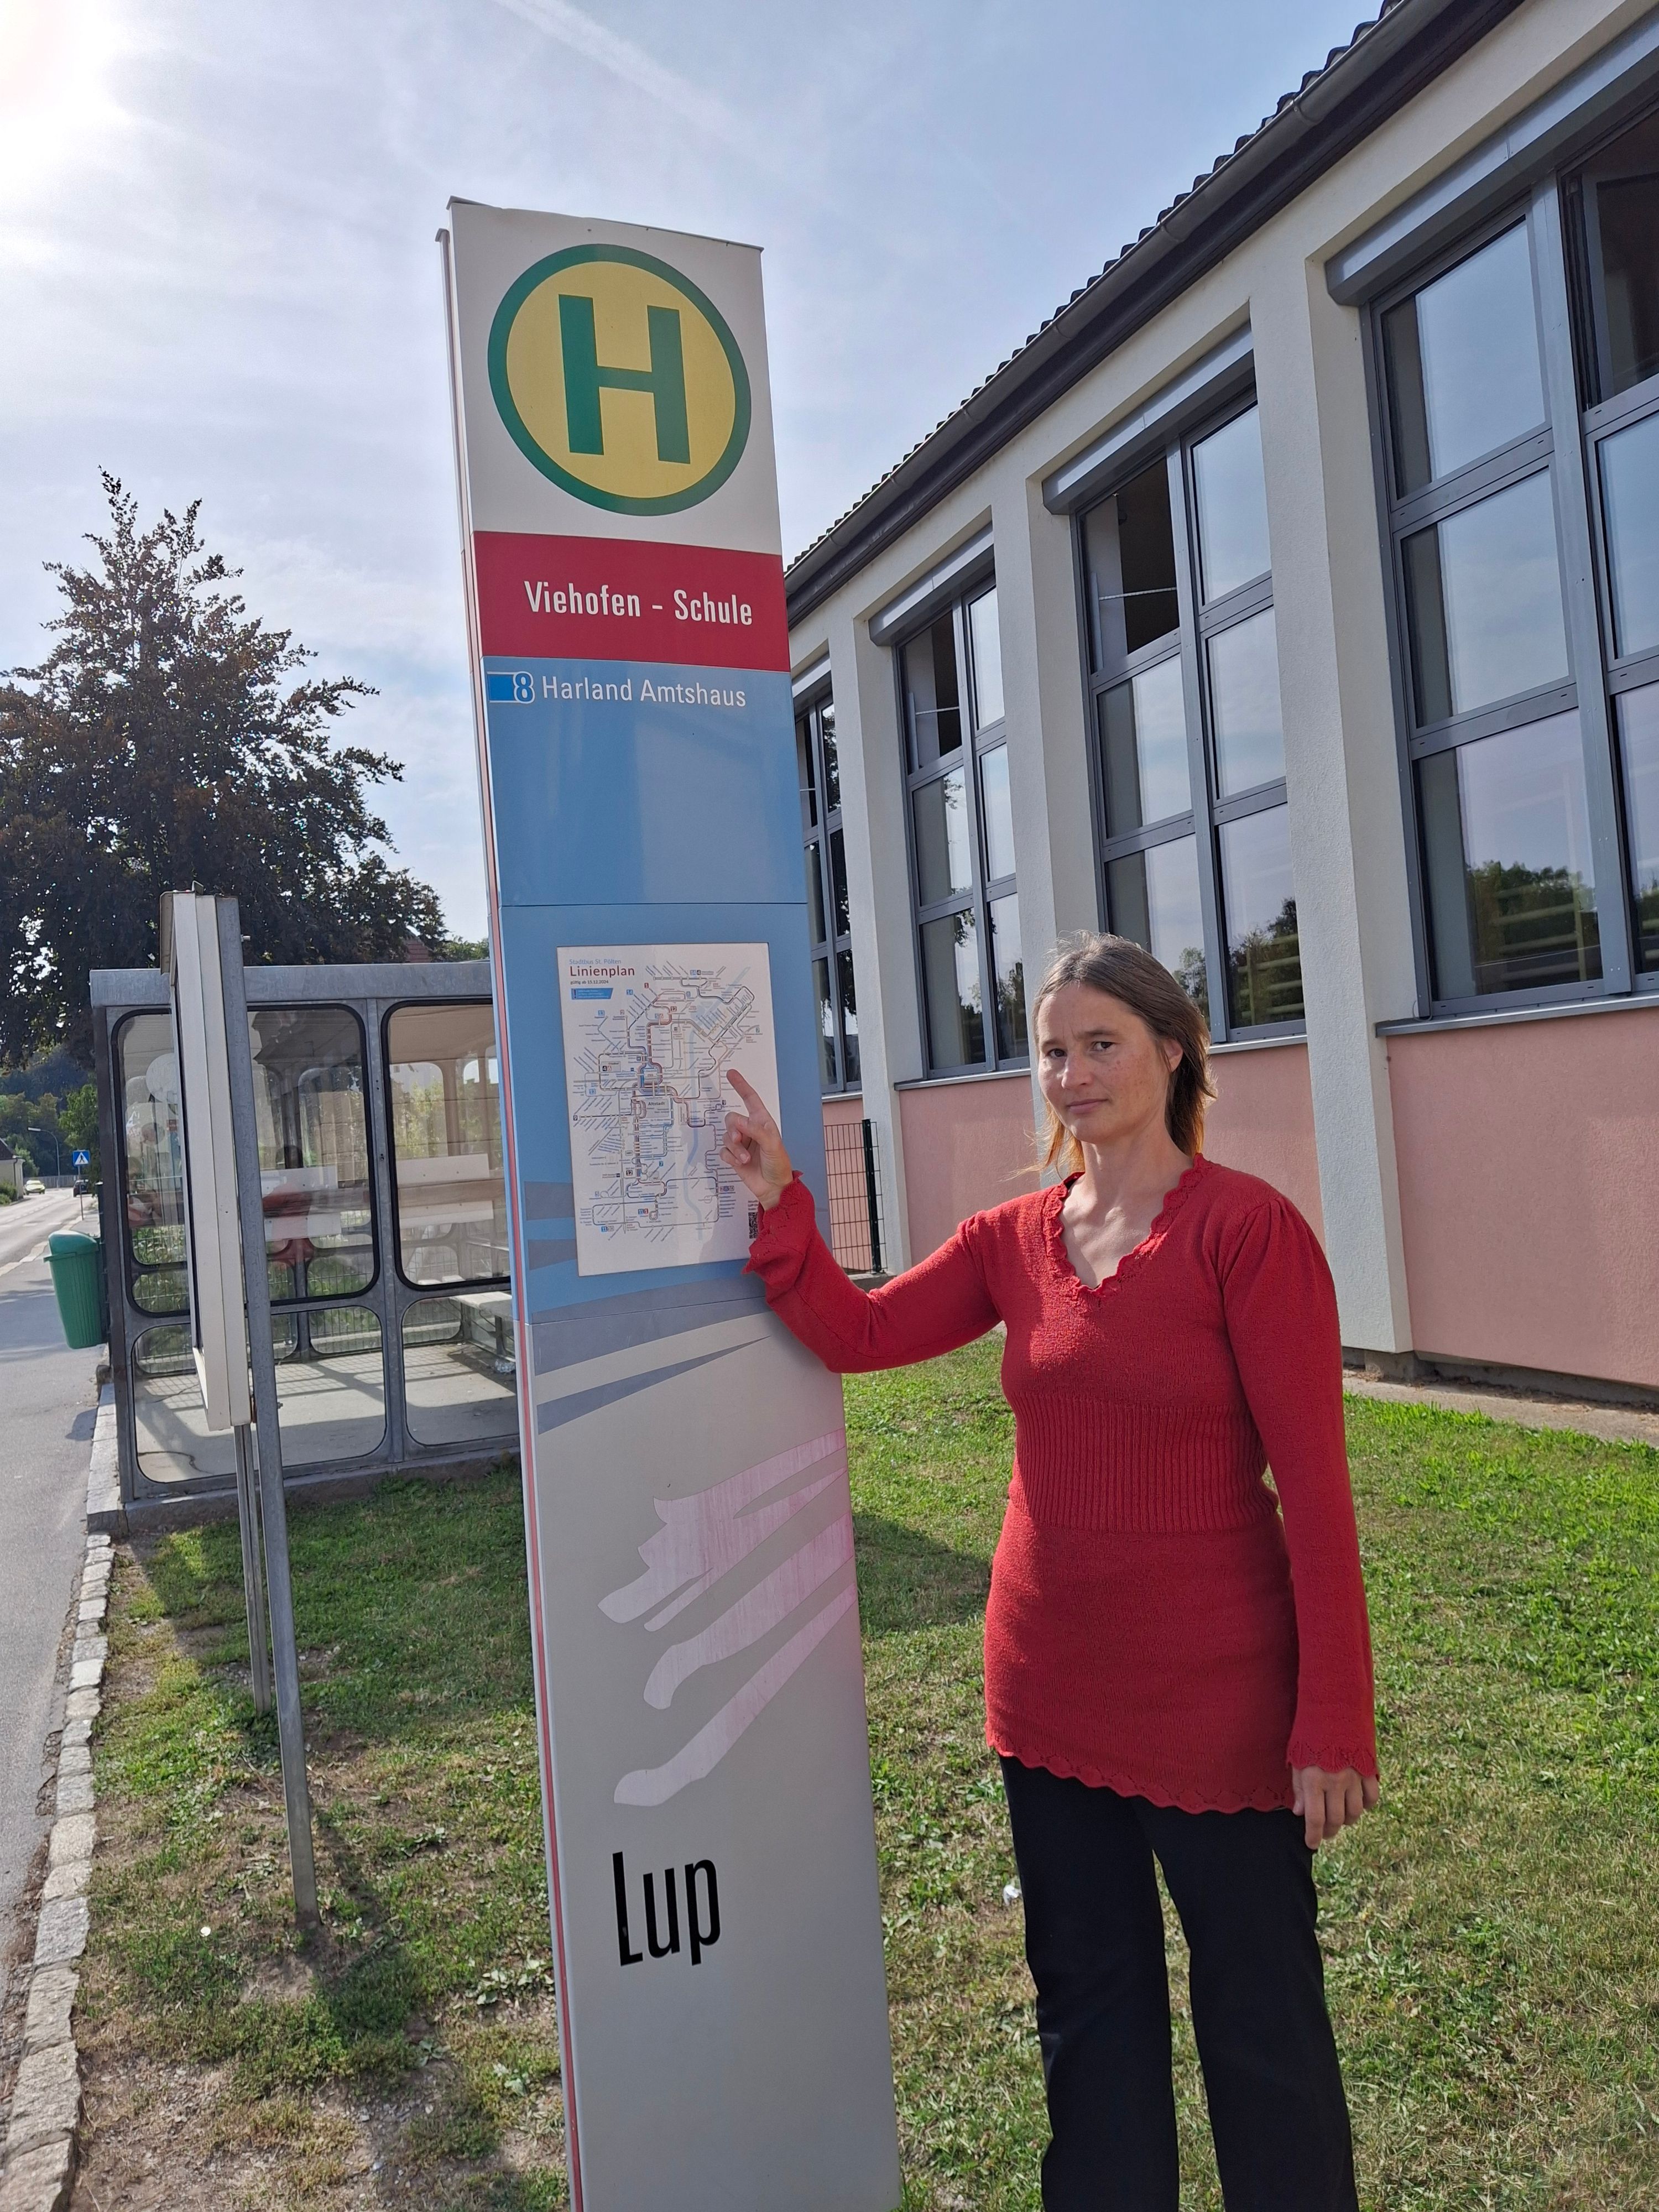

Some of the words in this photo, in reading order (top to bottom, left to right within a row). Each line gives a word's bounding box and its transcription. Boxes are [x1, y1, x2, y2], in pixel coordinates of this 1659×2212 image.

[559, 294, 691, 464] H
[524, 581, 640, 617] Viehofen
[674, 589, 753, 625] Schule
[513, 671, 534, 704] 8
[542, 675, 633, 701] Harland
[640, 679, 747, 707] Amtshaus
[570, 965, 635, 978] Linienplan
[613, 1851, 721, 1966] Lup
